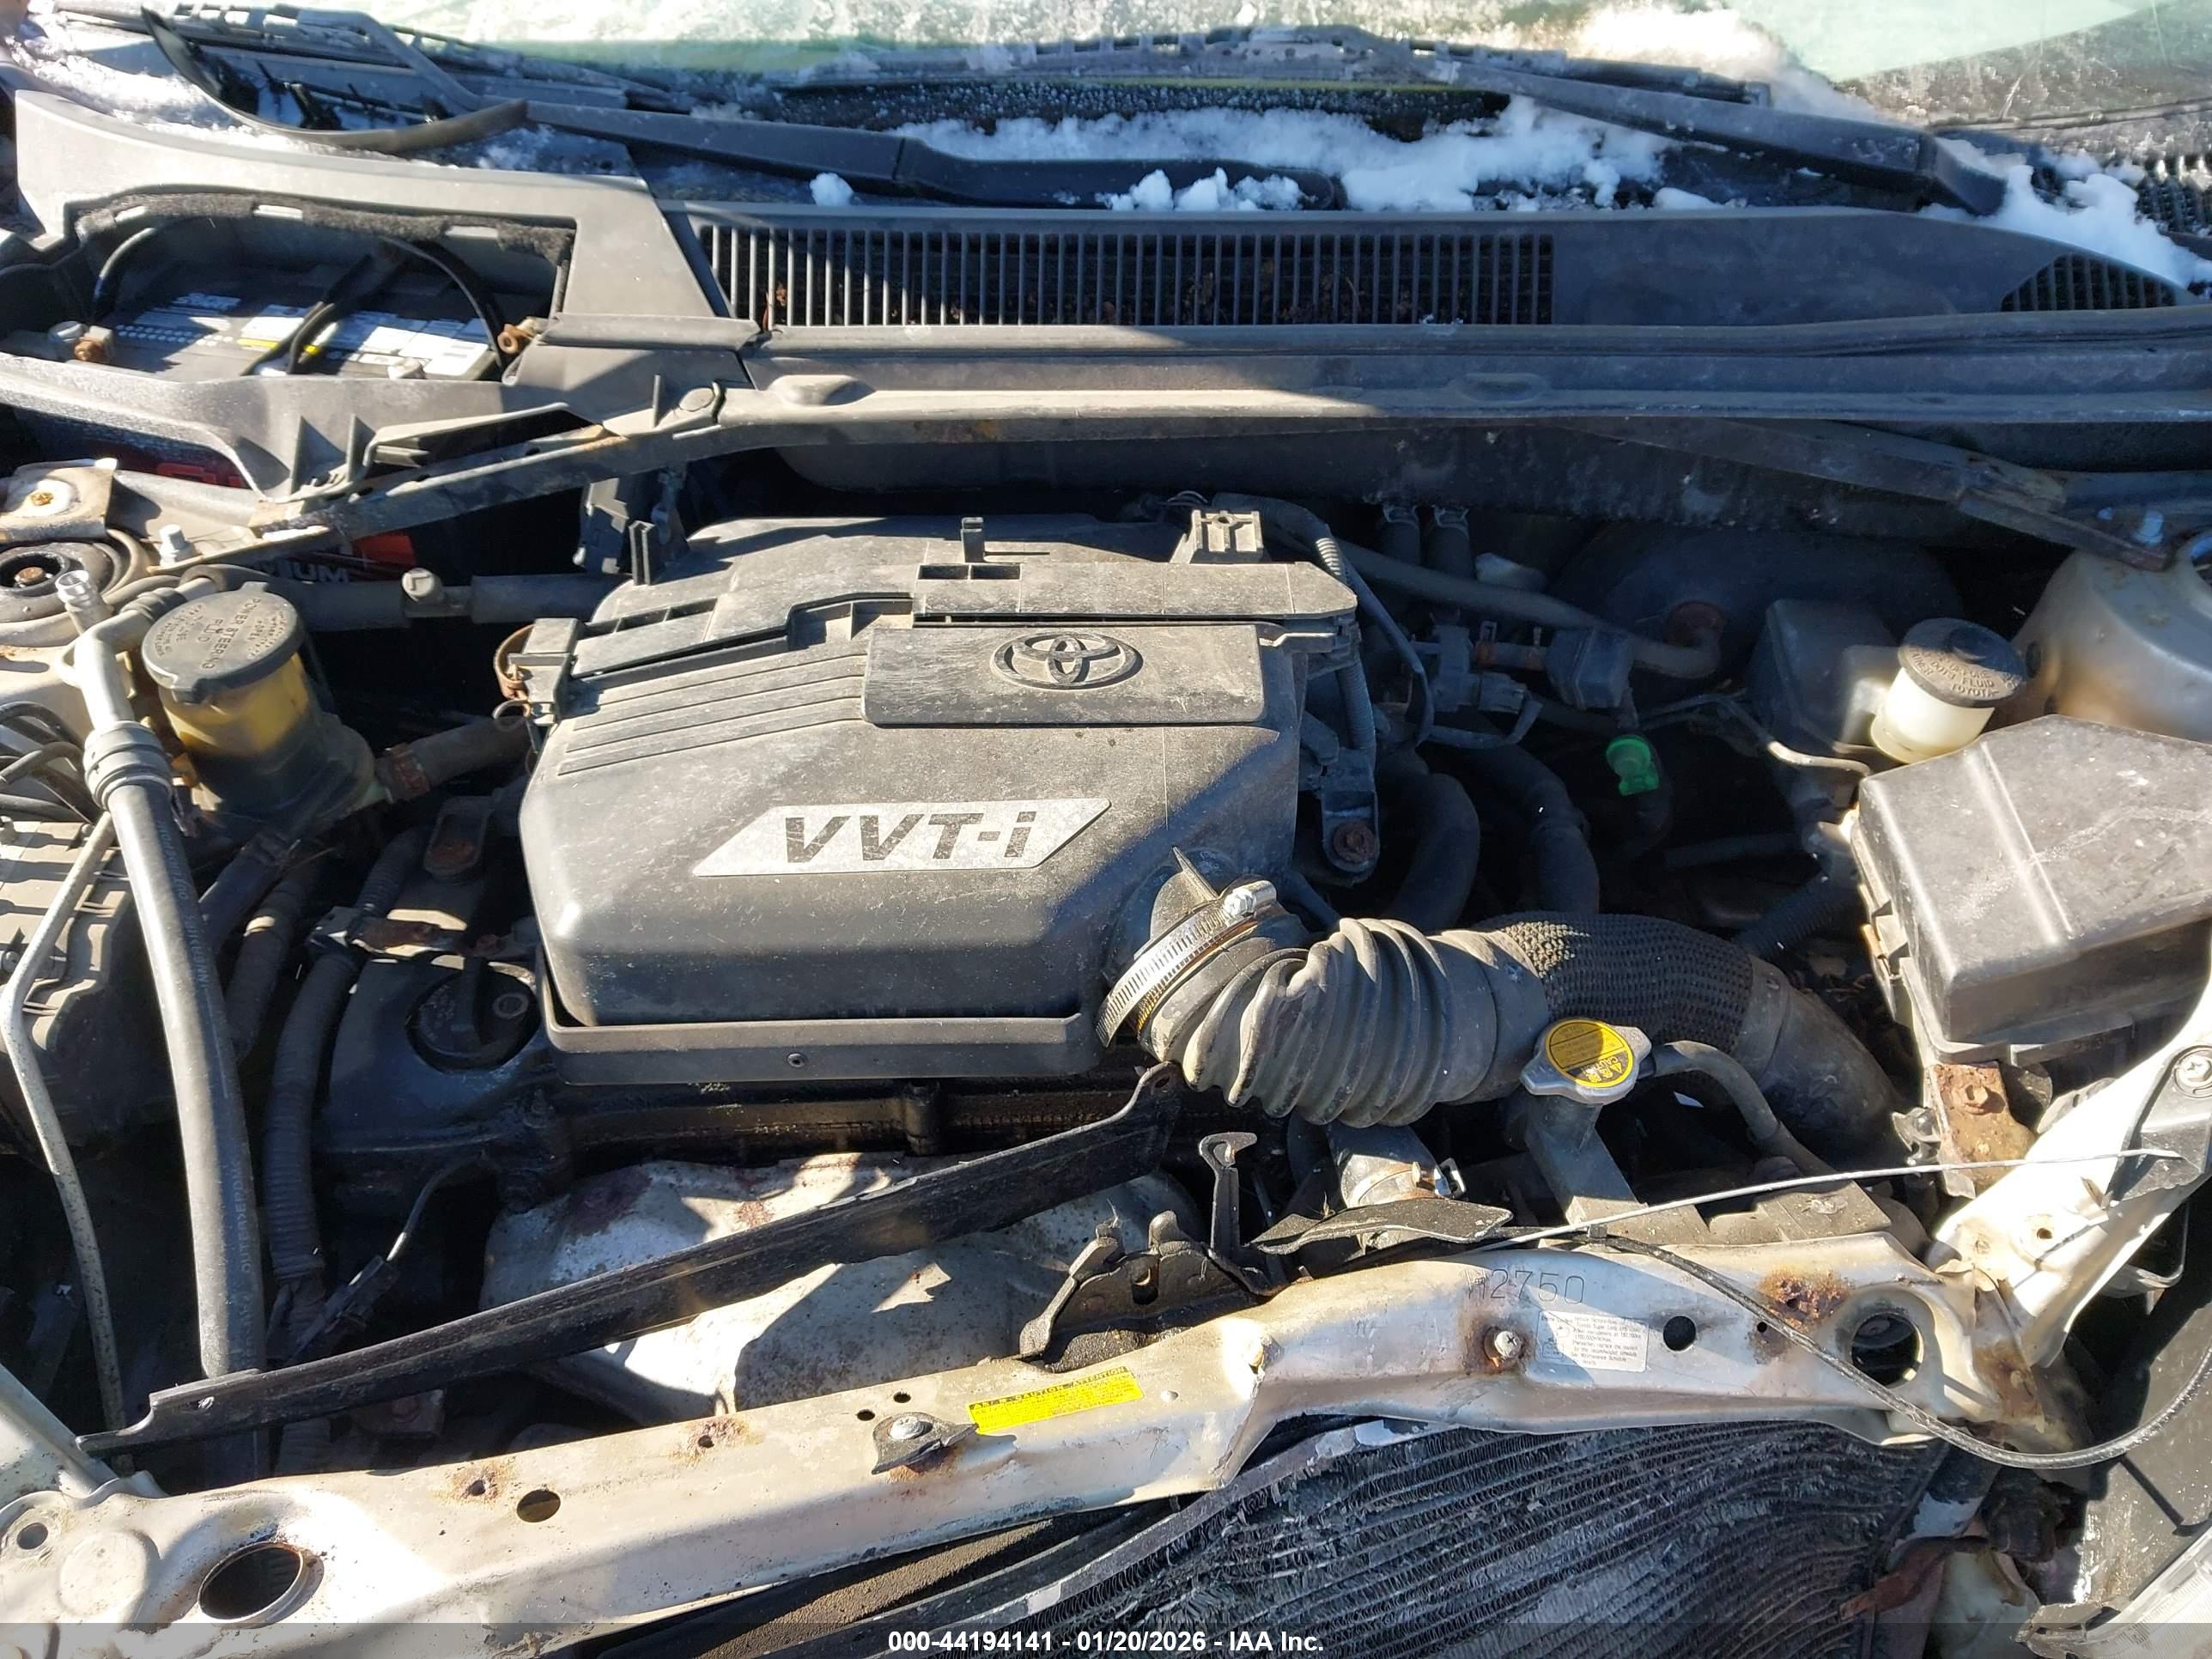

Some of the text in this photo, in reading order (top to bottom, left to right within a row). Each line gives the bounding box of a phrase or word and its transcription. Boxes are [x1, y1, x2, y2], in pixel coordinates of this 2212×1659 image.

[201, 599, 261, 670] POWER STEERING
[1952, 684, 1999, 698] TOYOTA
[1962, 678, 1996, 688] FLUID
[785, 811, 1036, 864] VVT-i
[1016, 1385, 1063, 1401] CAUTION
